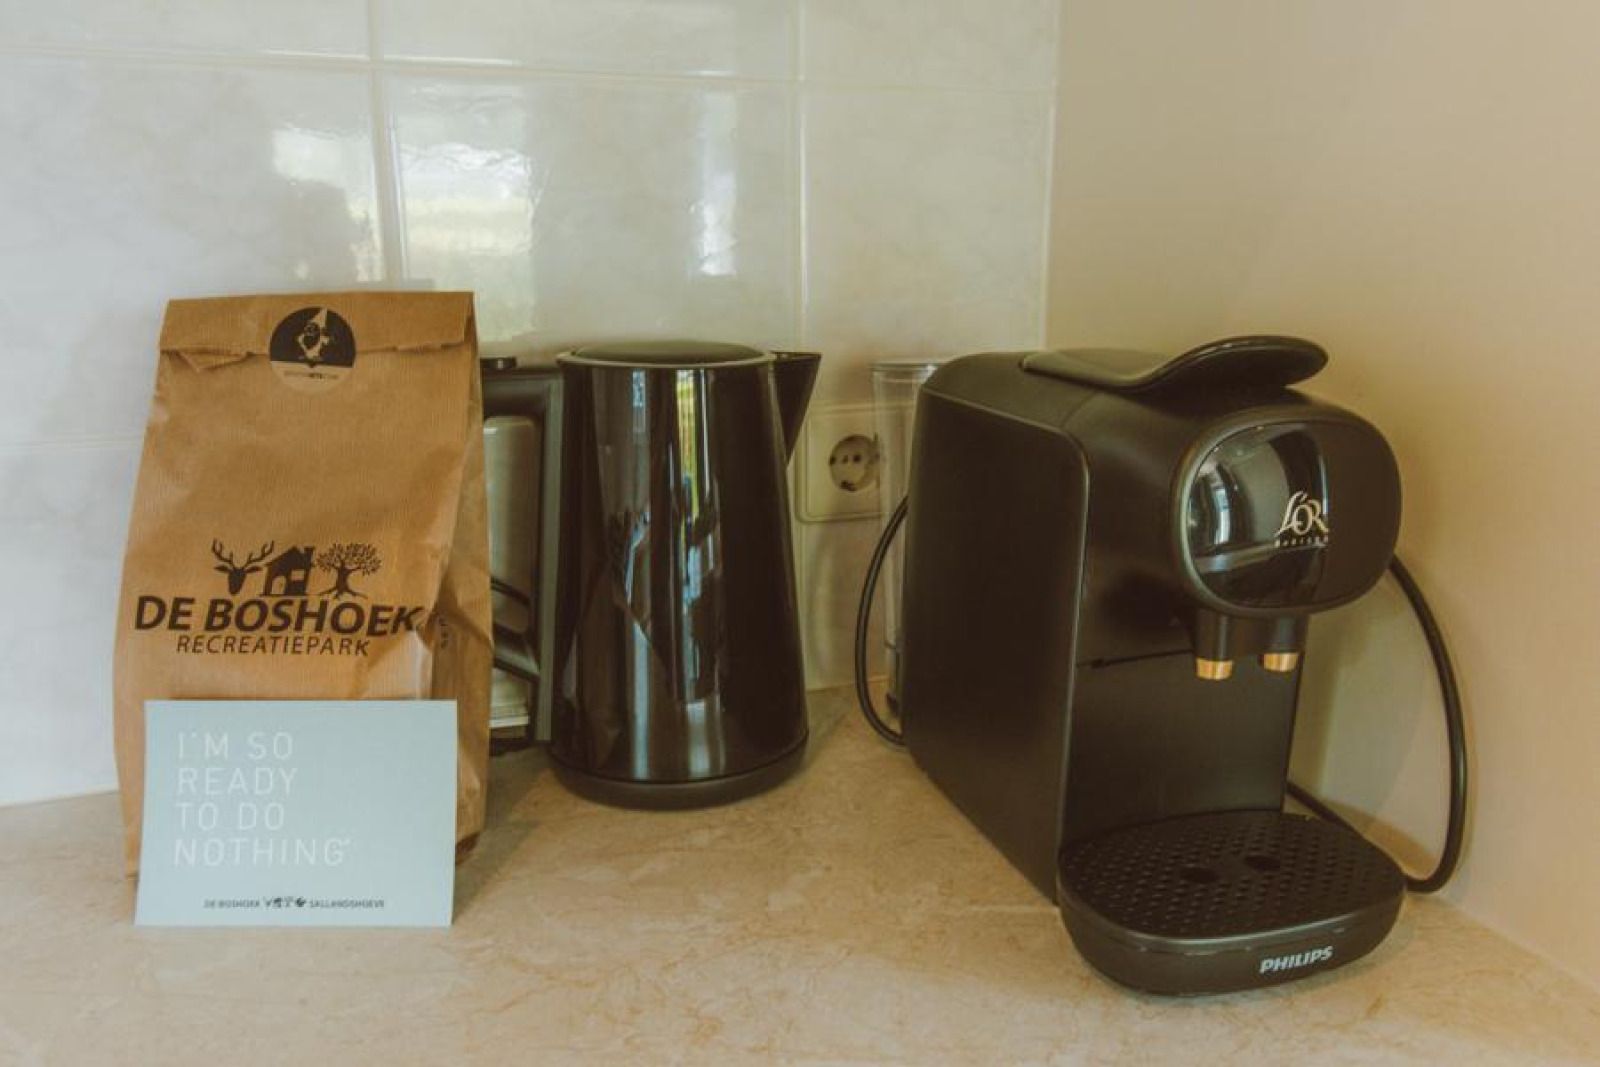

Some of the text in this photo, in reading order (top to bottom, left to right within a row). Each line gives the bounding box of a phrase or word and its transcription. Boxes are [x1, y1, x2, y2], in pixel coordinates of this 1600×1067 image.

[135, 596, 195, 631] DE
[204, 599, 424, 637] BOSHOEK
[177, 635, 370, 656] RECREATIEPARK
[178, 731, 293, 760] I'M SO
[178, 768, 298, 796] READY
[176, 802, 285, 831] TO DO
[1260, 945, 1334, 973] PHILIPS
